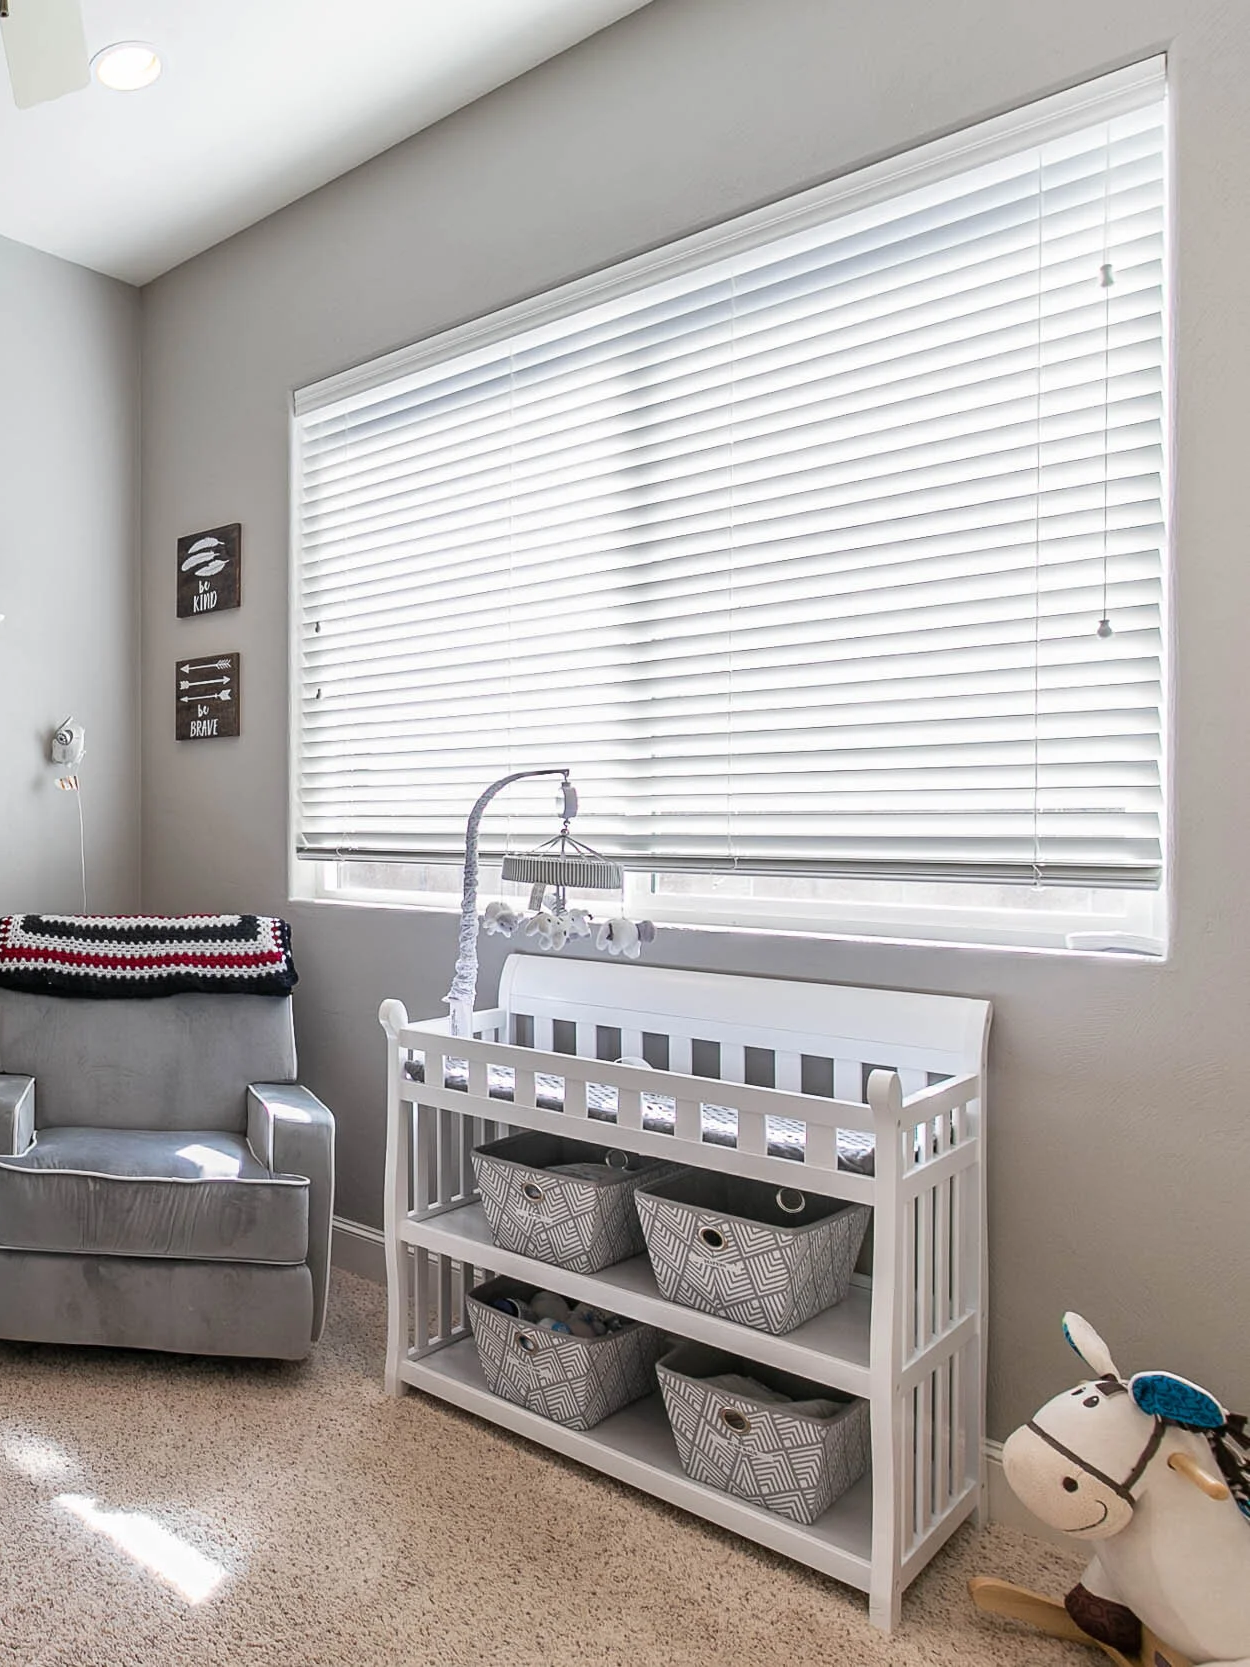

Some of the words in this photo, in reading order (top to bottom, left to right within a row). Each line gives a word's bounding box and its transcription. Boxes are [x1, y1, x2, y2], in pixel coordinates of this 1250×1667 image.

[198, 580, 211, 594] be
[193, 590, 218, 613] KIND
[197, 704, 210, 718] be
[190, 718, 219, 737] BRAVE
